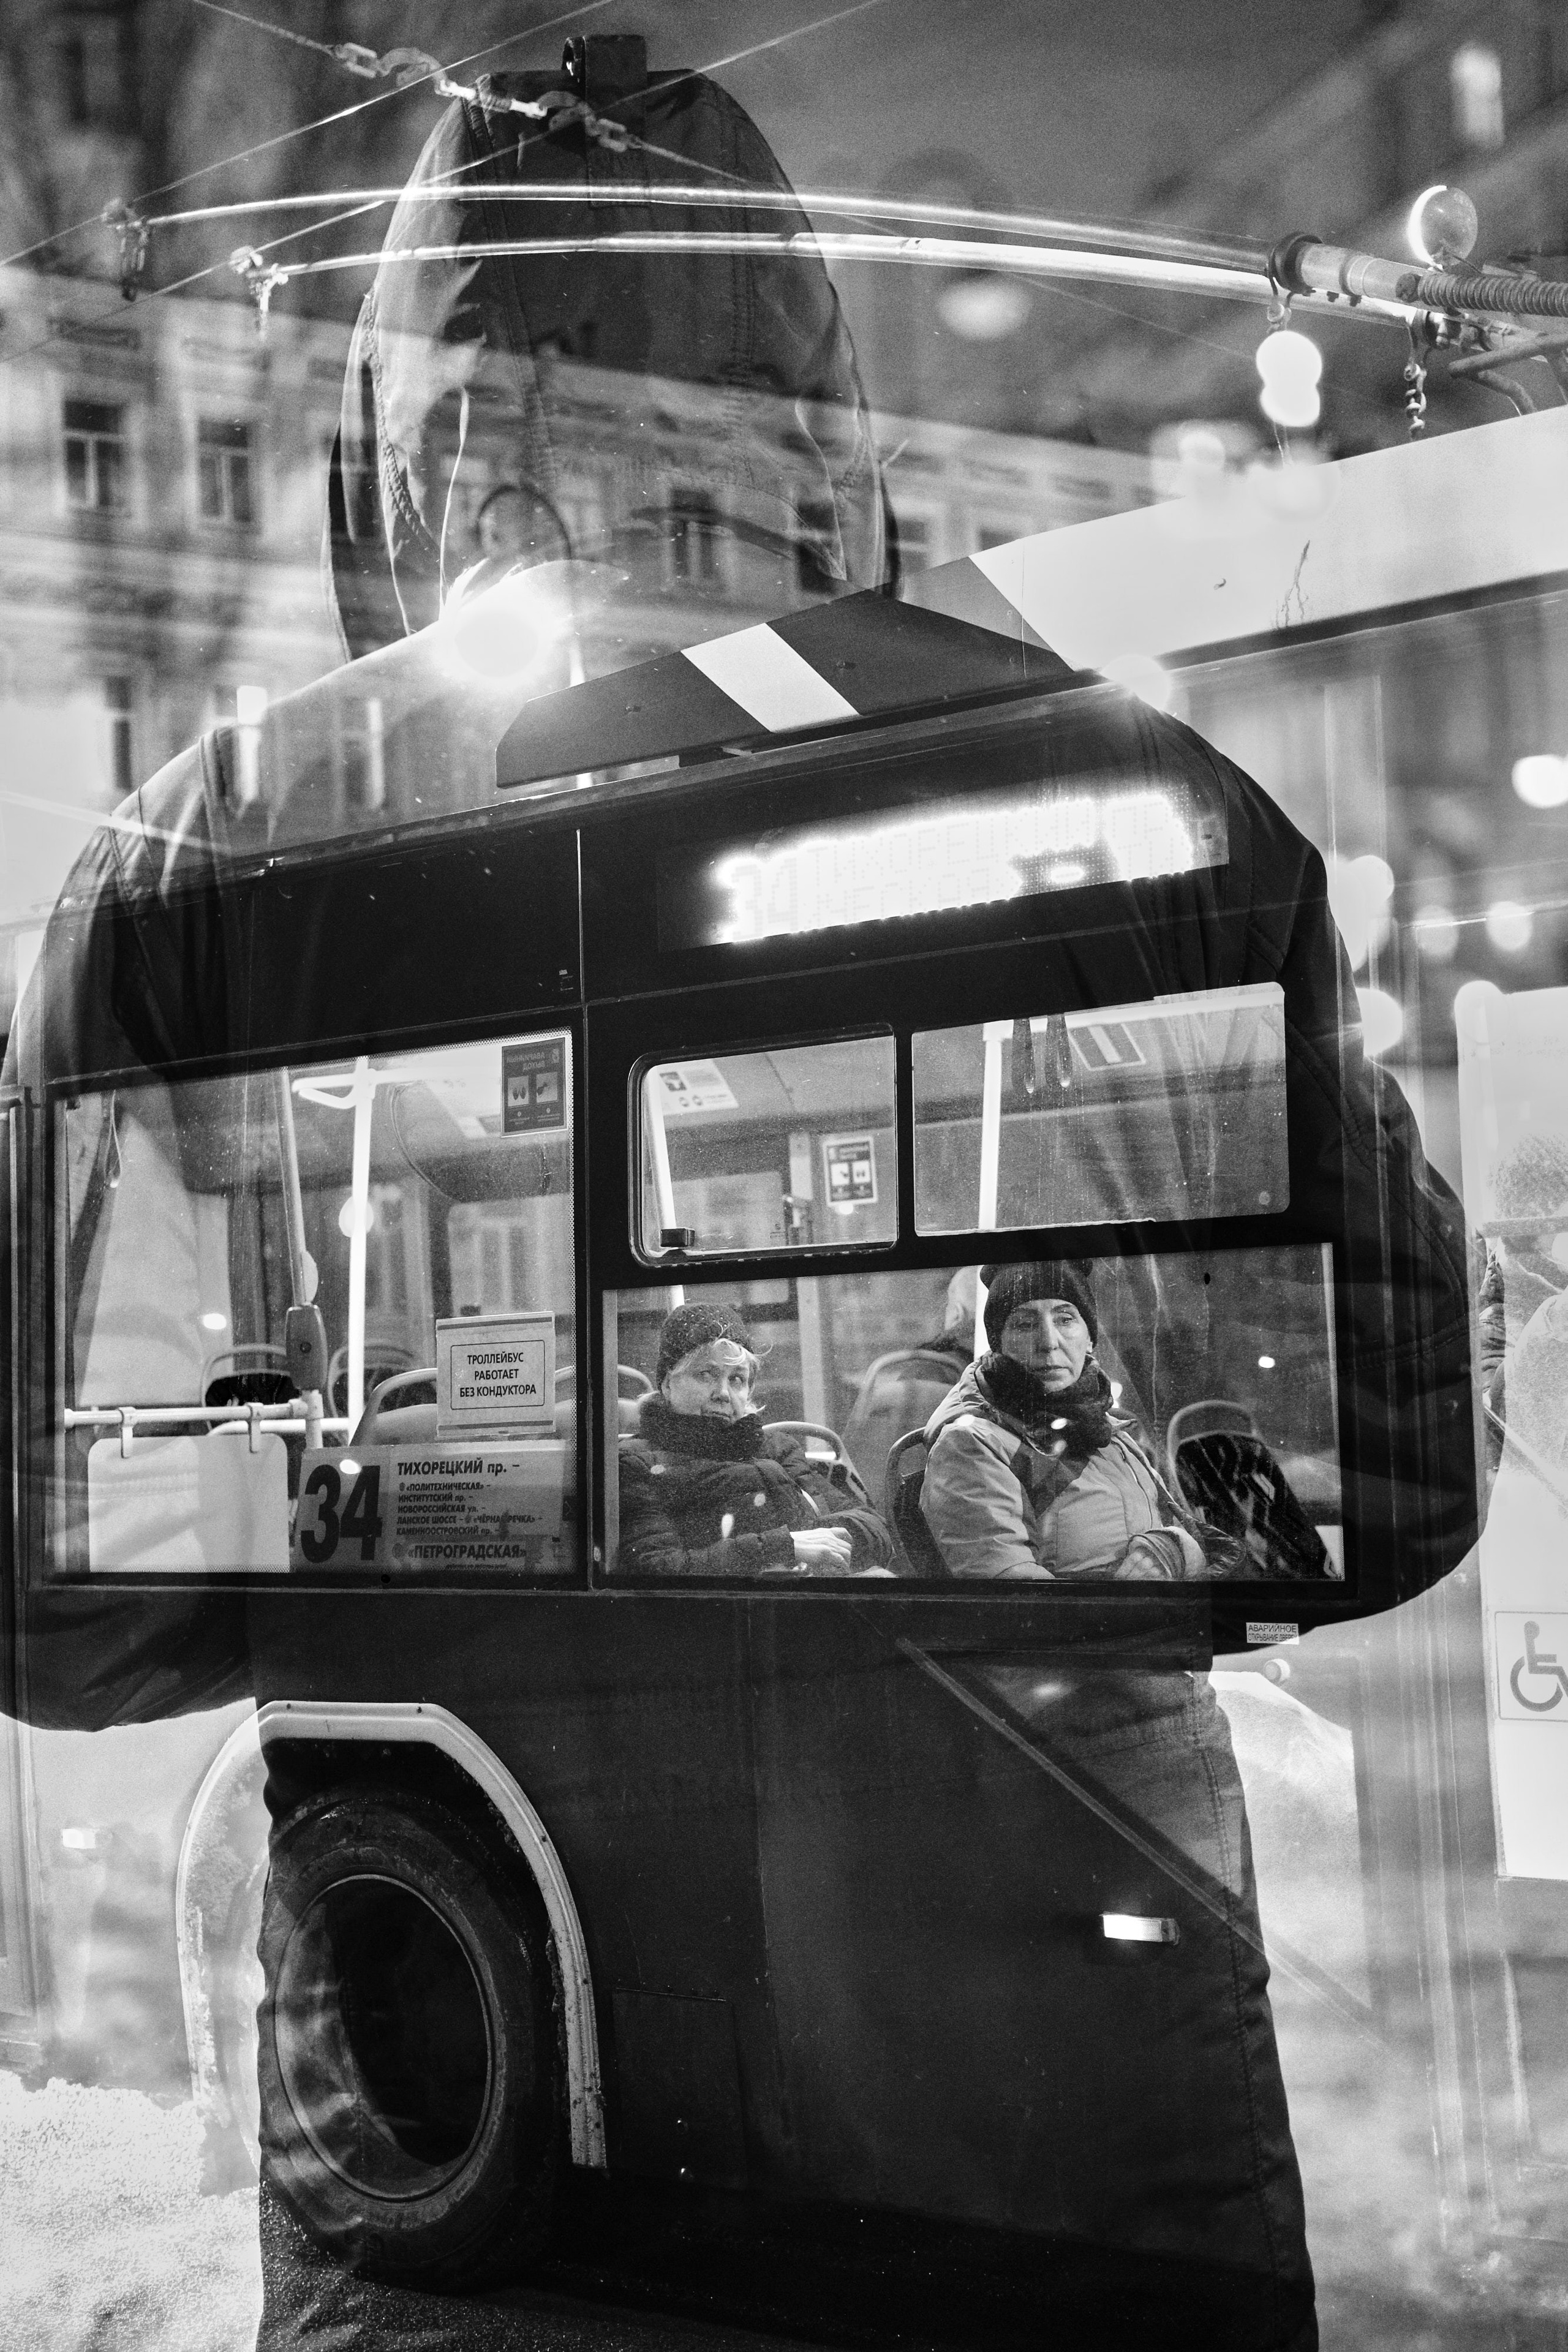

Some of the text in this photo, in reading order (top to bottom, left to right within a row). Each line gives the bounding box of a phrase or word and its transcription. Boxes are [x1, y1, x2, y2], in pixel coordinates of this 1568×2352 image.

[467, 1351, 524, 1365] ТРОЛЛЕЙБУС
[474, 1368, 519, 1381] РАБОТАЕТ
[459, 1384, 537, 1398] БЕЗ КОНДУКТОРА
[397, 1457, 483, 1476] ТИХОРЕЦКИЙ
[487, 1463, 508, 1477] пр.
[398, 1491, 453, 1502] ИНСТИТУТСКИЙ
[300, 1463, 383, 1564] 34
[398, 1502, 466, 1513] НОВОРОССИЙСКАЯ
[396, 1515, 430, 1525] ЛАНСКОЕ
[431, 1515, 457, 1524] ШОССЕ
[1248, 1624, 1297, 1633] АВАРИЙНОЕ
